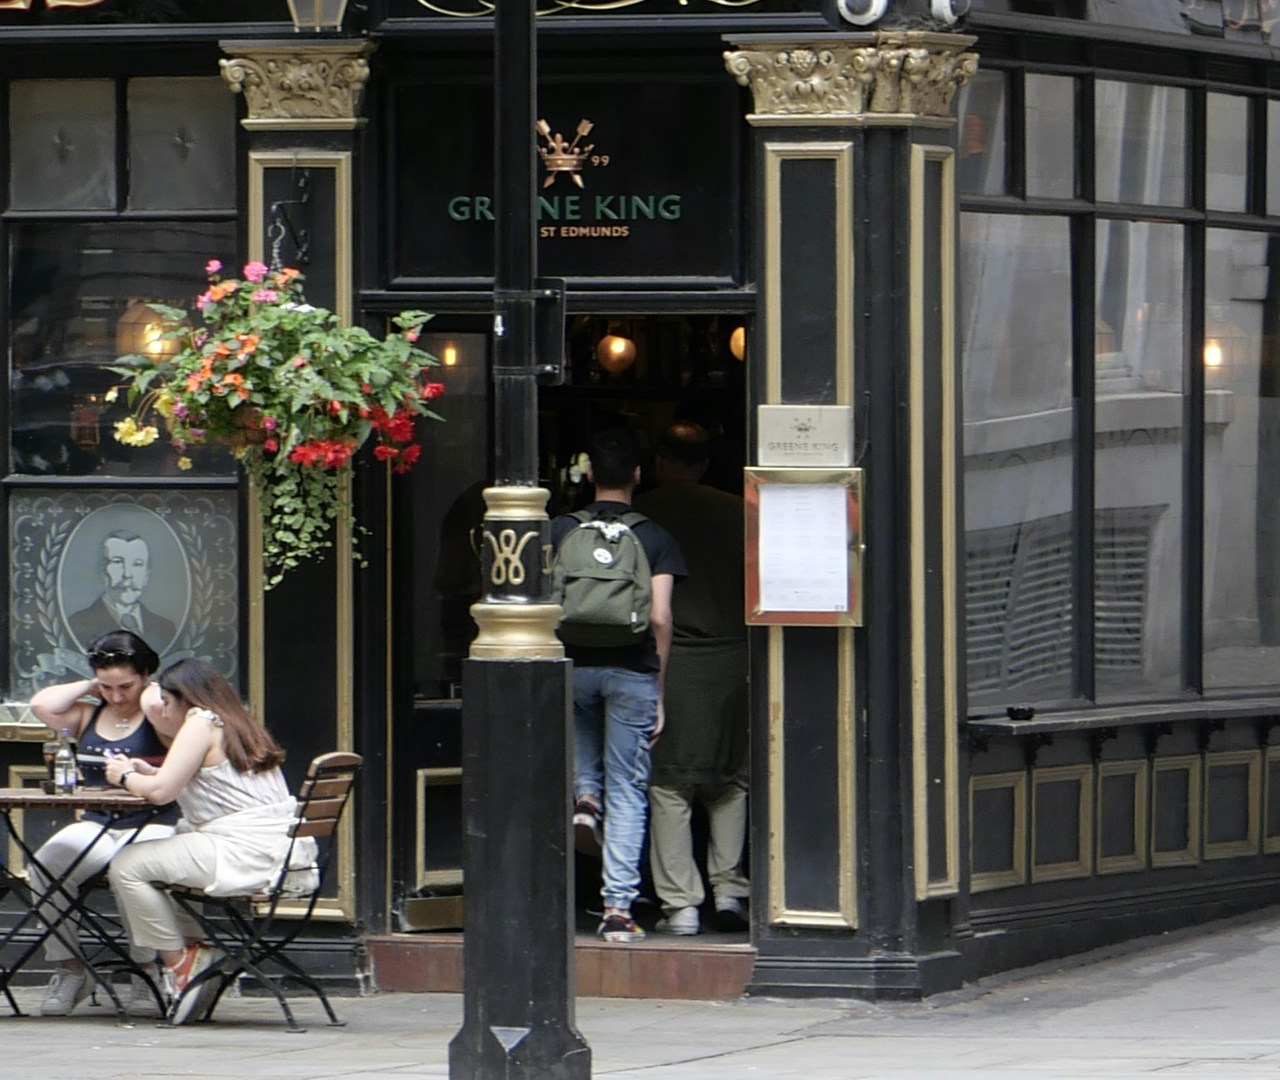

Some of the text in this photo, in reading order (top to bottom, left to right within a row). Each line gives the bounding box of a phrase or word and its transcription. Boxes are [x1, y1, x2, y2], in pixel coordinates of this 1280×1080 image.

[591, 155, 610, 167] 99
[448, 194, 682, 221] GRNE KING
[540, 226, 630, 238] ST EDMUNDS
[768, 442, 809, 452] GREENE
